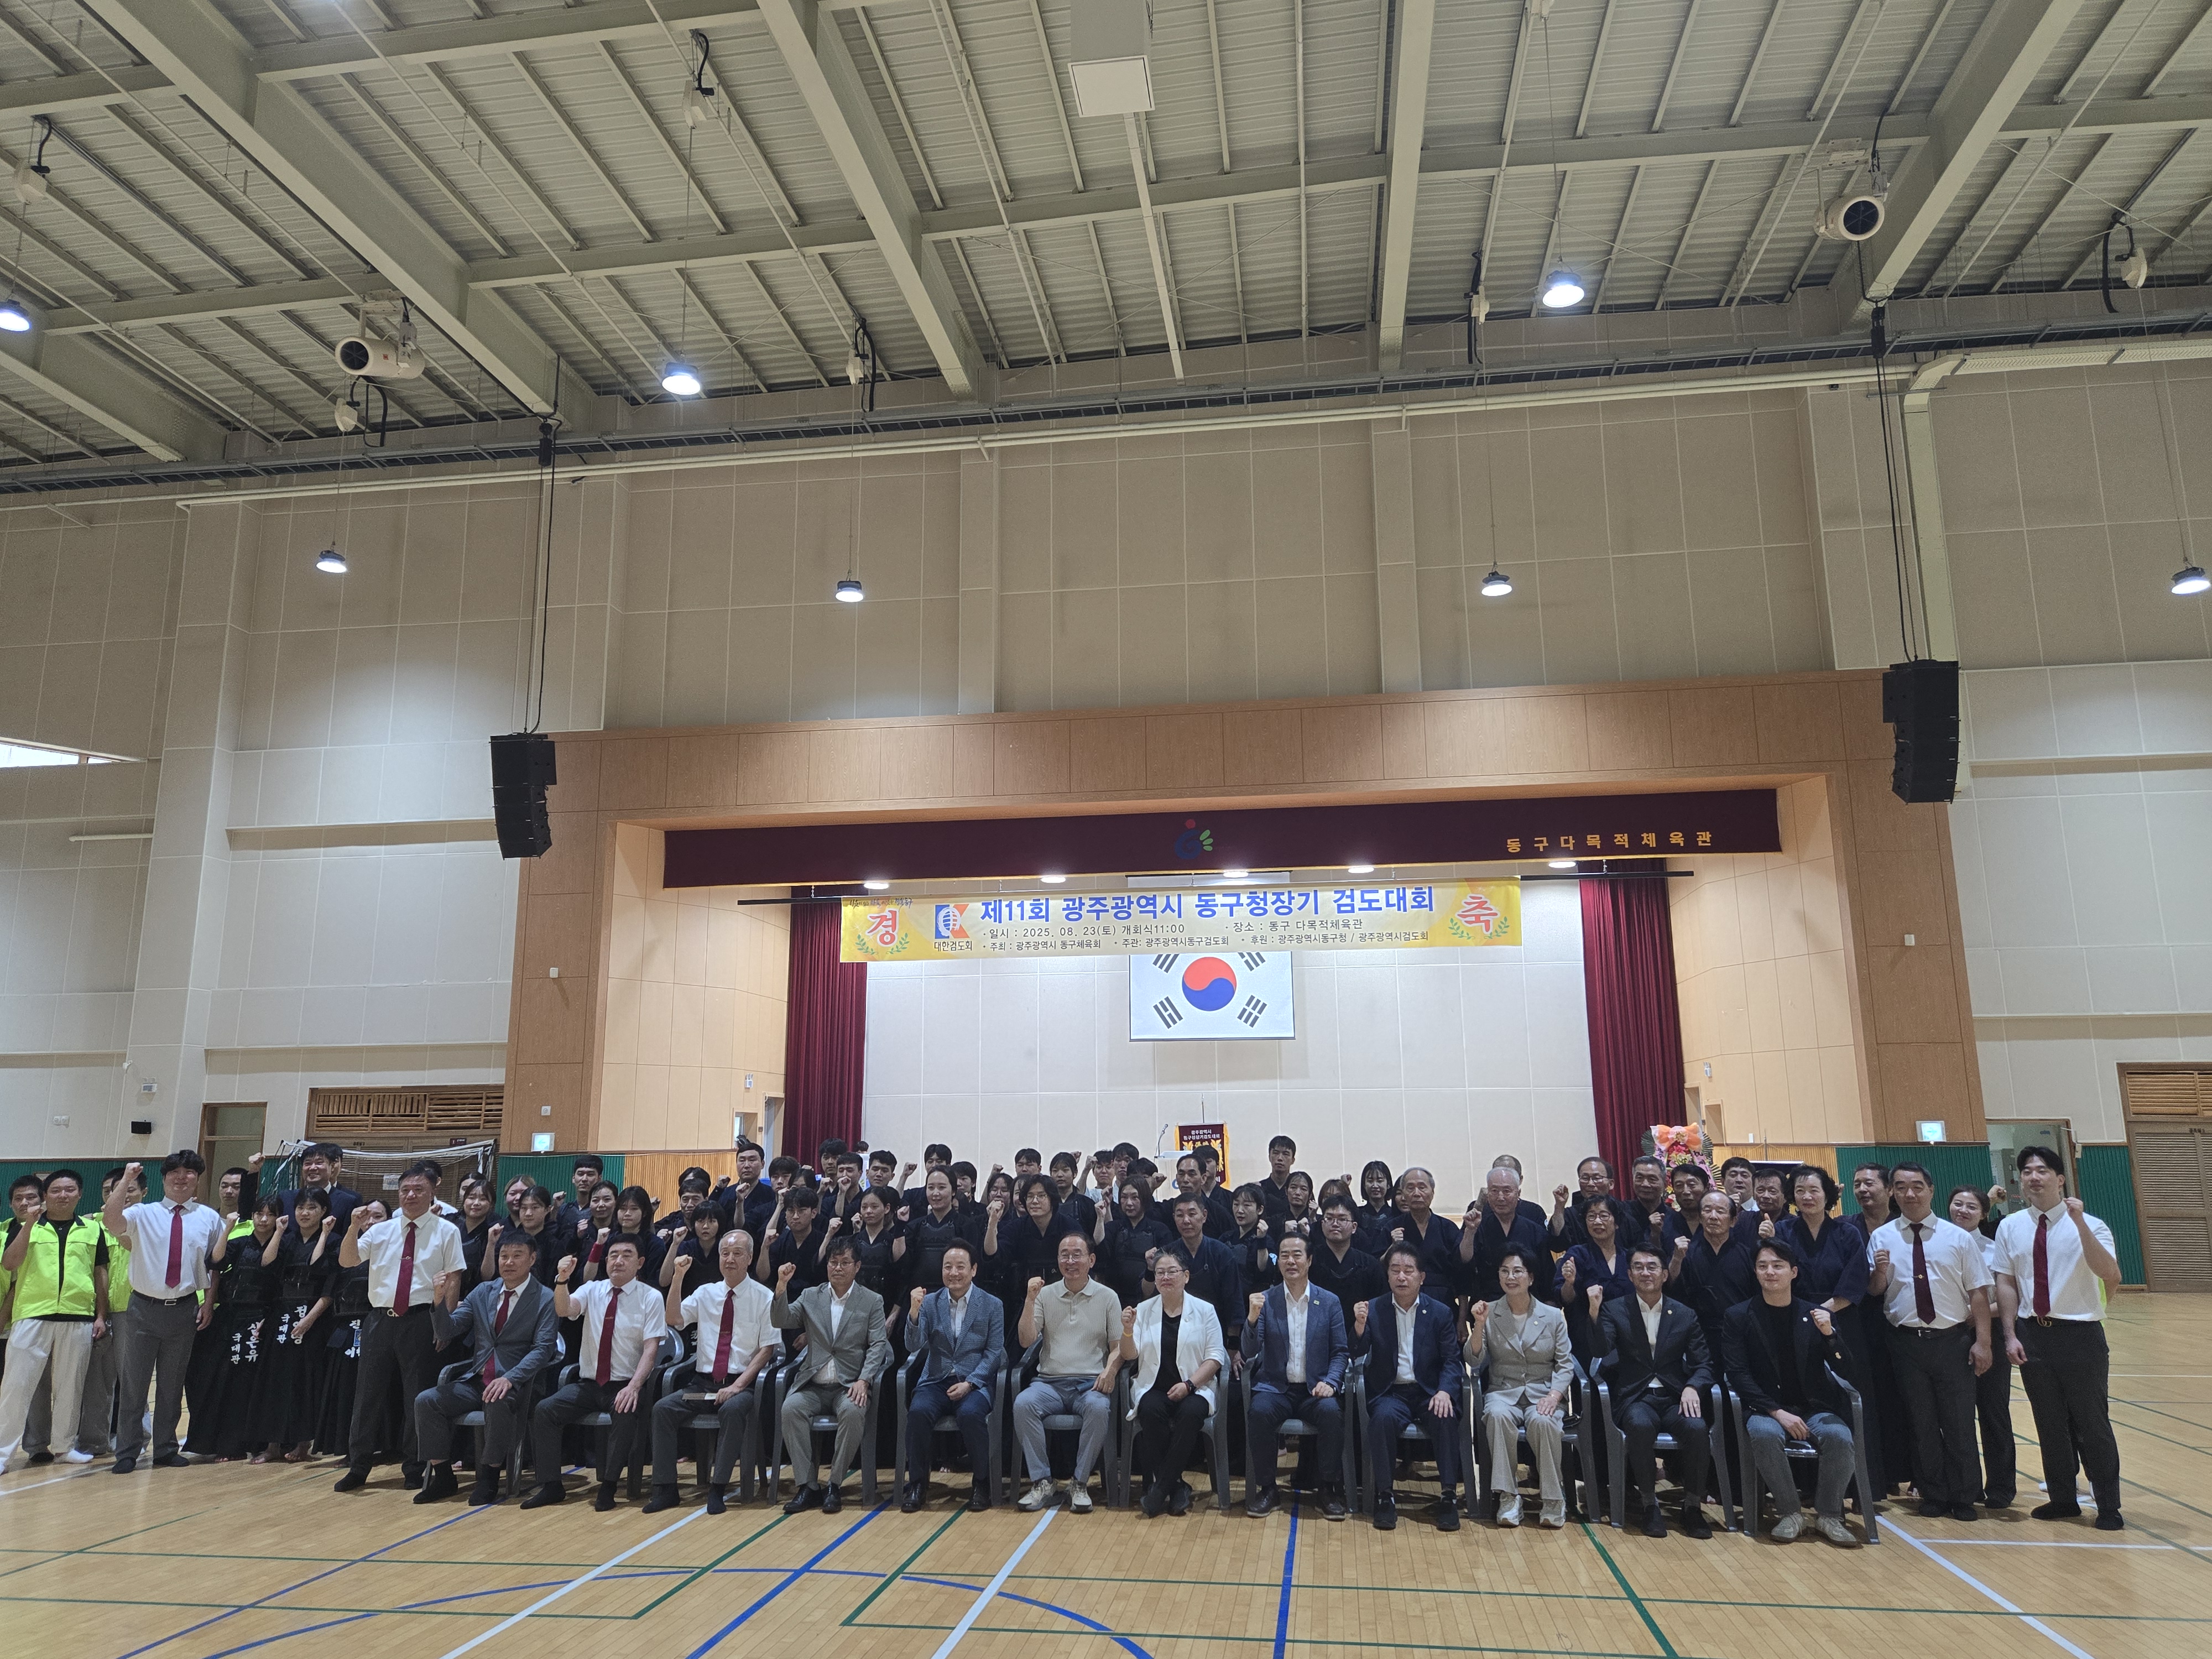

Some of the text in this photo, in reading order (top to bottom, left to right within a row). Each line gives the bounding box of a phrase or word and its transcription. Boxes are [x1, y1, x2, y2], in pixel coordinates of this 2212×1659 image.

[1507, 832, 1712, 853] 동구다목적체육관
[980, 886, 1433, 924] 제11회 광주광역시 동구청장기 검도대회
[1457, 896, 1498, 932] 축
[867, 910, 897, 945] 경
[989, 928, 1009, 938] 일시
[1023, 928, 1054, 937] 2025.
[1060, 927, 1077, 937] 08.
[1083, 925, 1116, 936] 23(토)
[1121, 924, 1185, 936] 개회식11:00
[1233, 922, 1255, 932] 장소
[1269, 921, 1290, 932] 동구
[1296, 919, 1363, 931] 다목적체육관
[990, 942, 1006, 951] 주최
[1016, 941, 1056, 951] 광주광역시
[1060, 939, 1100, 949] 동구체육회
[1145, 936, 1229, 948] 광주광역시동구검도회
[1250, 935, 1267, 945] 후원
[1278, 933, 1347, 945] 광주광역시동구청
[1359, 931, 1428, 942] 광주광역시검도회
[934, 941, 972, 951] 대한검도회
